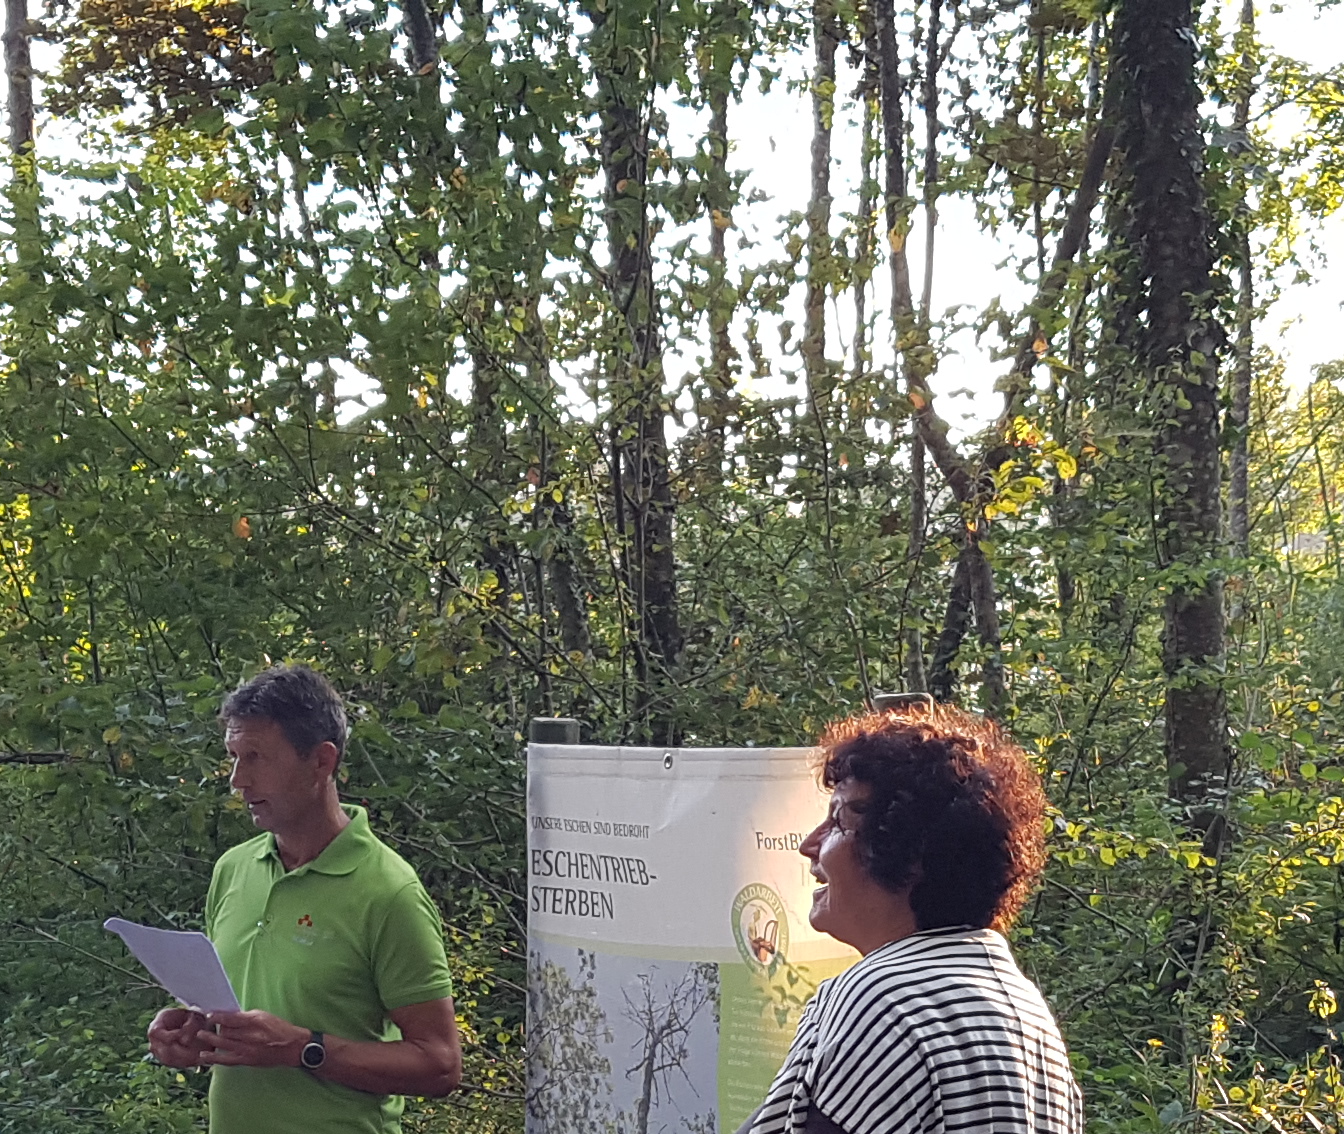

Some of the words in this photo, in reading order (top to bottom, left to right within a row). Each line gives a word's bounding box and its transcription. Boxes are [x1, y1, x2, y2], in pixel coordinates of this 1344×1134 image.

[531, 816, 563, 831] UNSERE
[564, 818, 592, 834] ESCHEN
[593, 821, 612, 836] SIND
[612, 822, 651, 839] BEDROHT
[531, 849, 658, 886] ESCHENTRIEB-
[531, 885, 615, 920] STERBEN
